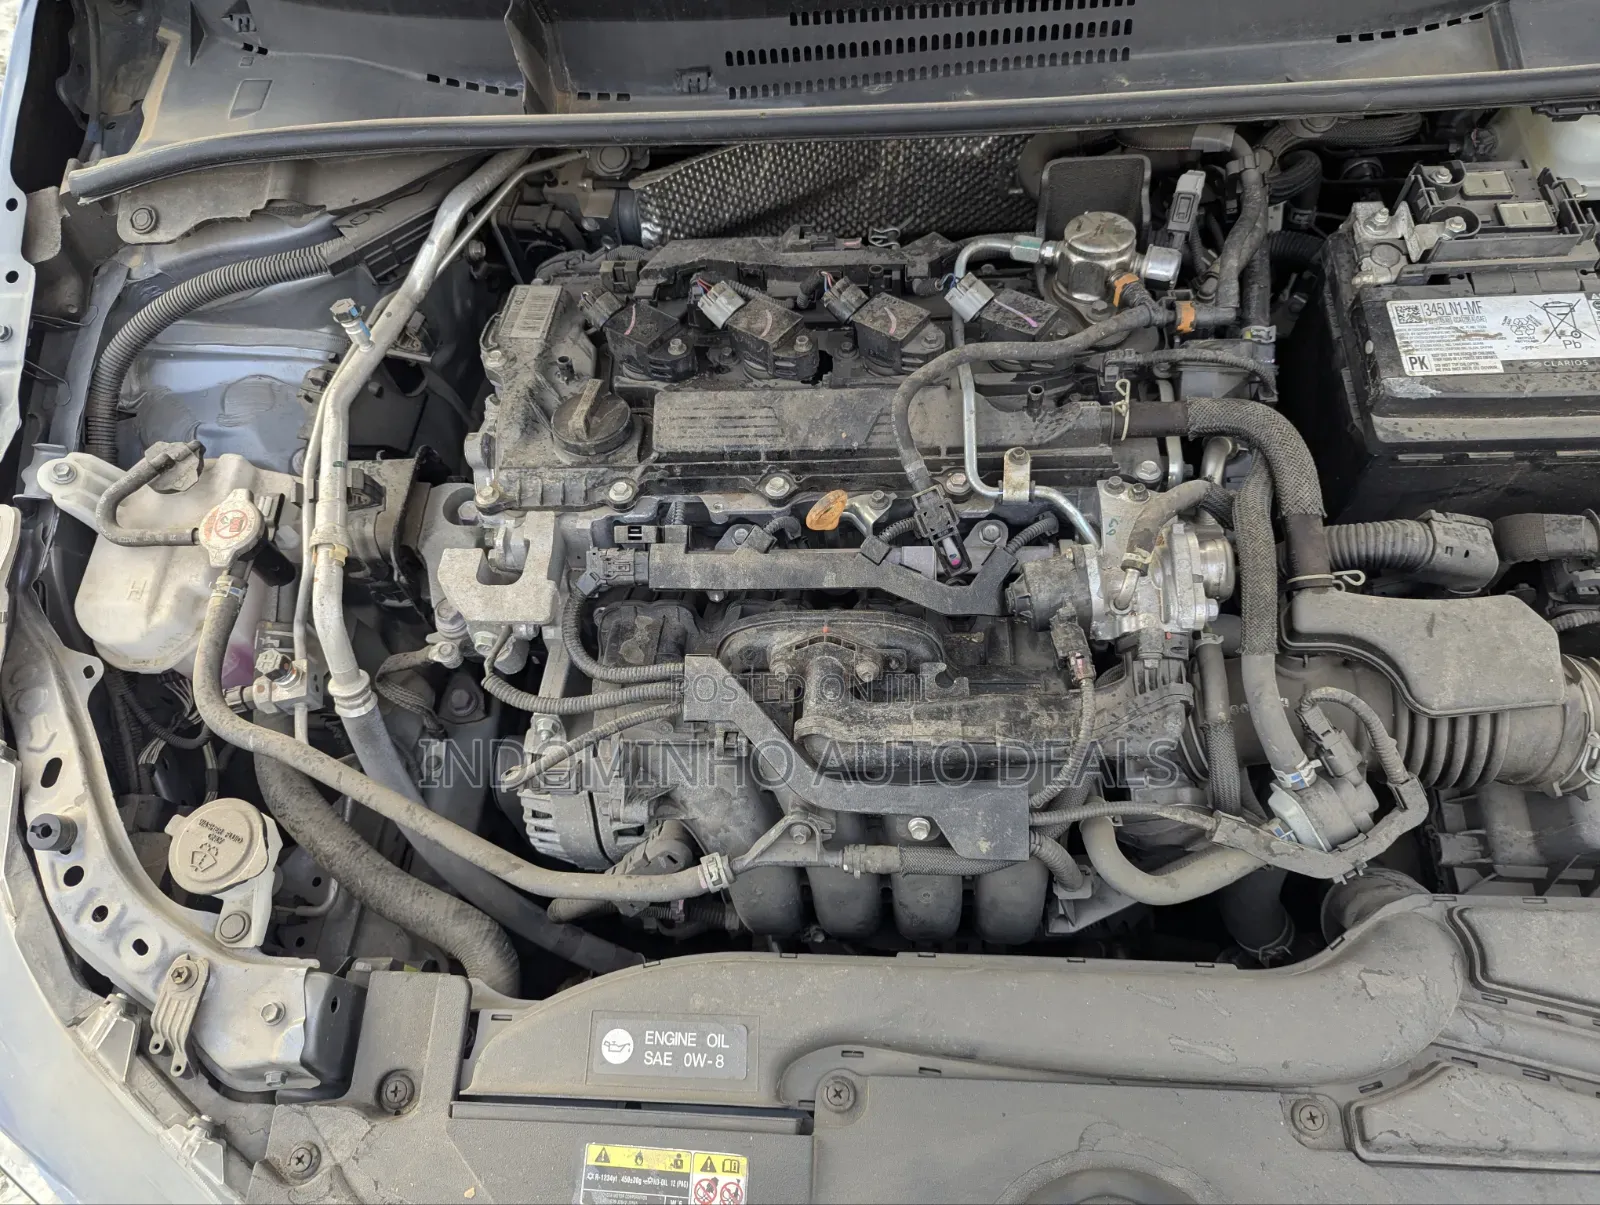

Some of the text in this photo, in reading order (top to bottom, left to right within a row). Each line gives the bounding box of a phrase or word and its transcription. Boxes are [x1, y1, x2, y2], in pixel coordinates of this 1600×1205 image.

[1424, 301, 1482, 317] 345LN1-MF
[1563, 340, 1582, 349] Pb
[1409, 356, 1429, 371] PK
[645, 1031, 730, 1048] ENGINE OIL
[643, 1051, 725, 1069] SAE 0W-8
